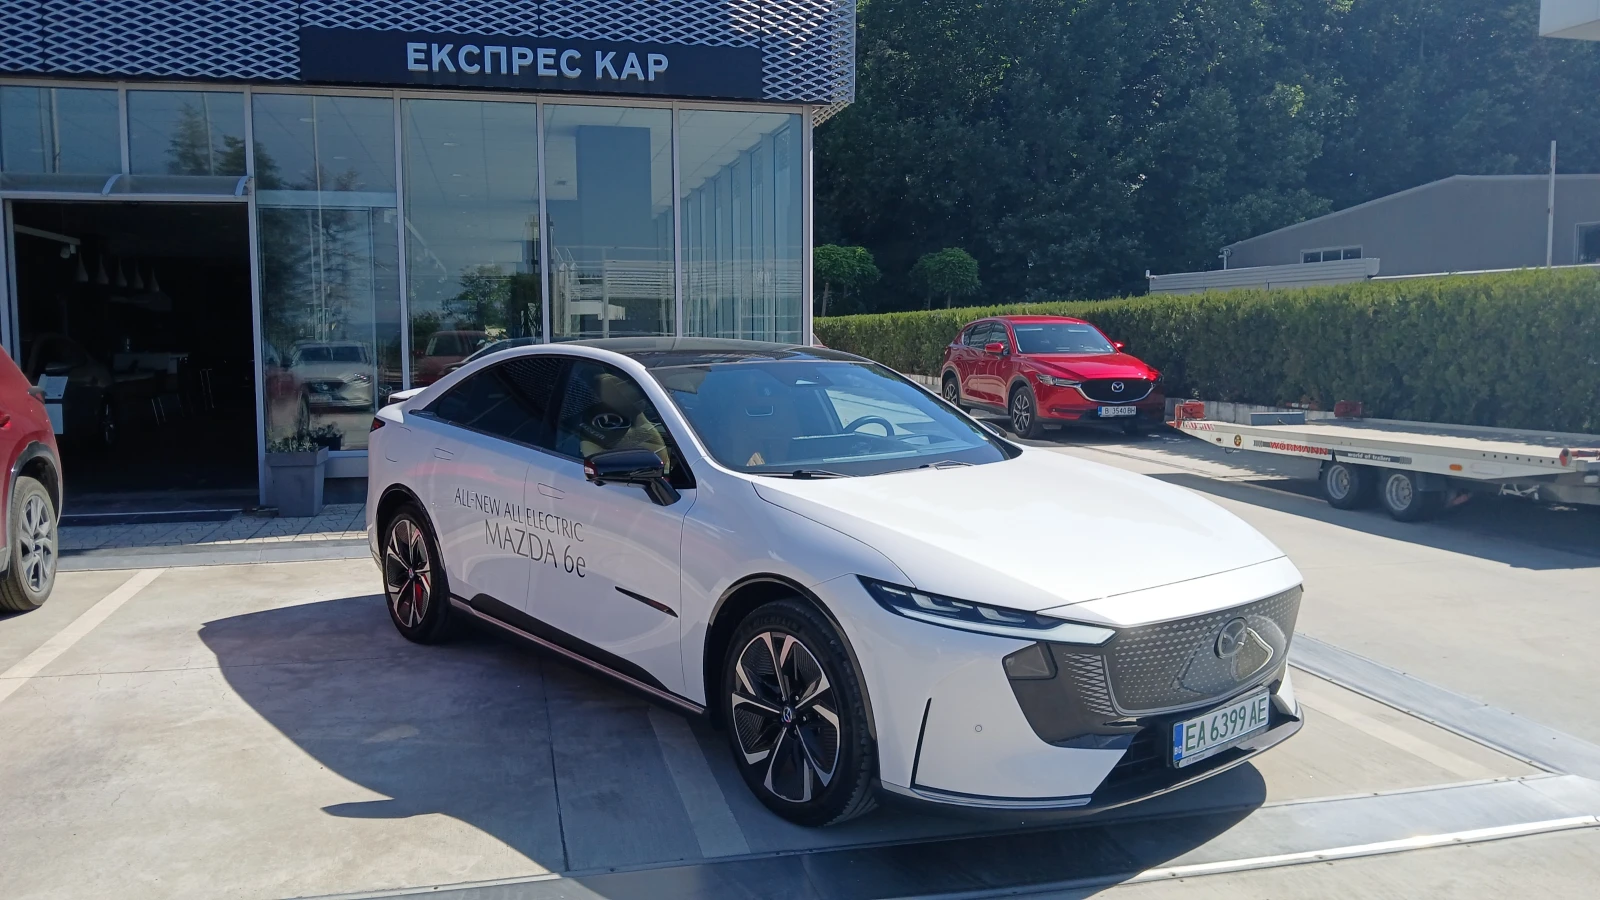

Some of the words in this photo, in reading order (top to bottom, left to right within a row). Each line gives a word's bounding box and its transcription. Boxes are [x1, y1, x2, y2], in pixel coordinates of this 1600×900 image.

[406, 42, 582, 79] ЕКСПРЕС
[595, 50, 669, 82] КАР
[1372, 454, 1391, 462] trailers
[454, 487, 501, 516] ALL-NEW
[503, 502, 524, 524] ALL
[526, 508, 585, 542] ELECTRIC
[485, 519, 558, 569] MAZDA
[563, 545, 586, 578] 6e
[1185, 720, 1206, 752] EA
[1210, 705, 1247, 742] 6399
[1249, 697, 1267, 728] AE
